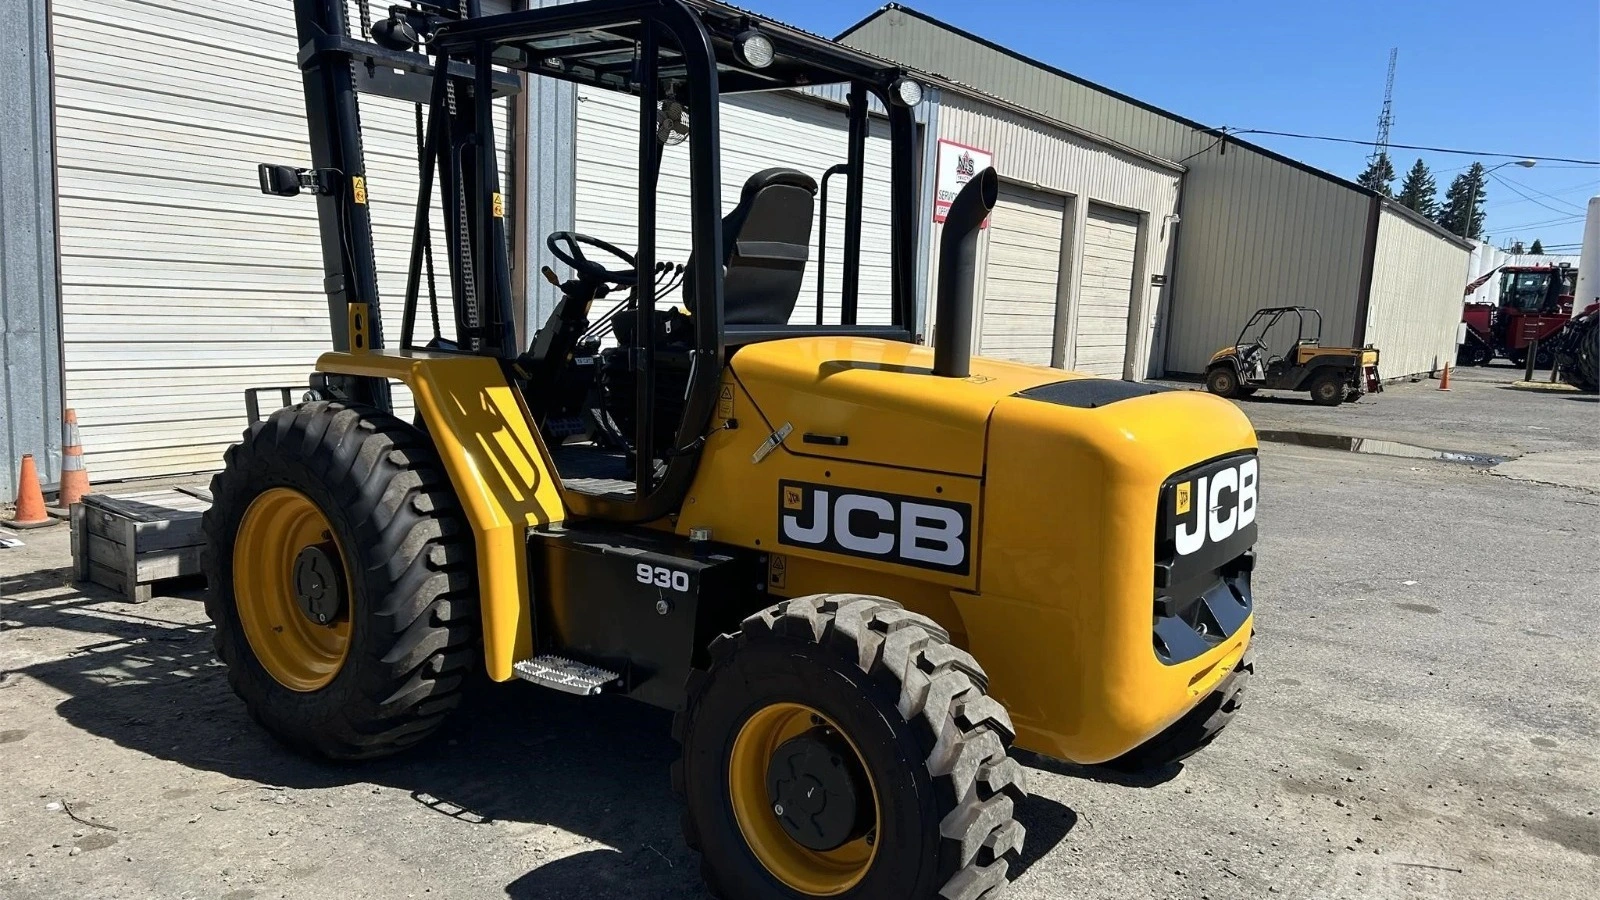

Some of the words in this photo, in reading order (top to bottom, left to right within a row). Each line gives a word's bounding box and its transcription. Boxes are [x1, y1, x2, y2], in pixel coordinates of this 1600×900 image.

[783, 489, 965, 566] JCB
[1176, 459, 1258, 555] JCB
[636, 563, 689, 592] 930
